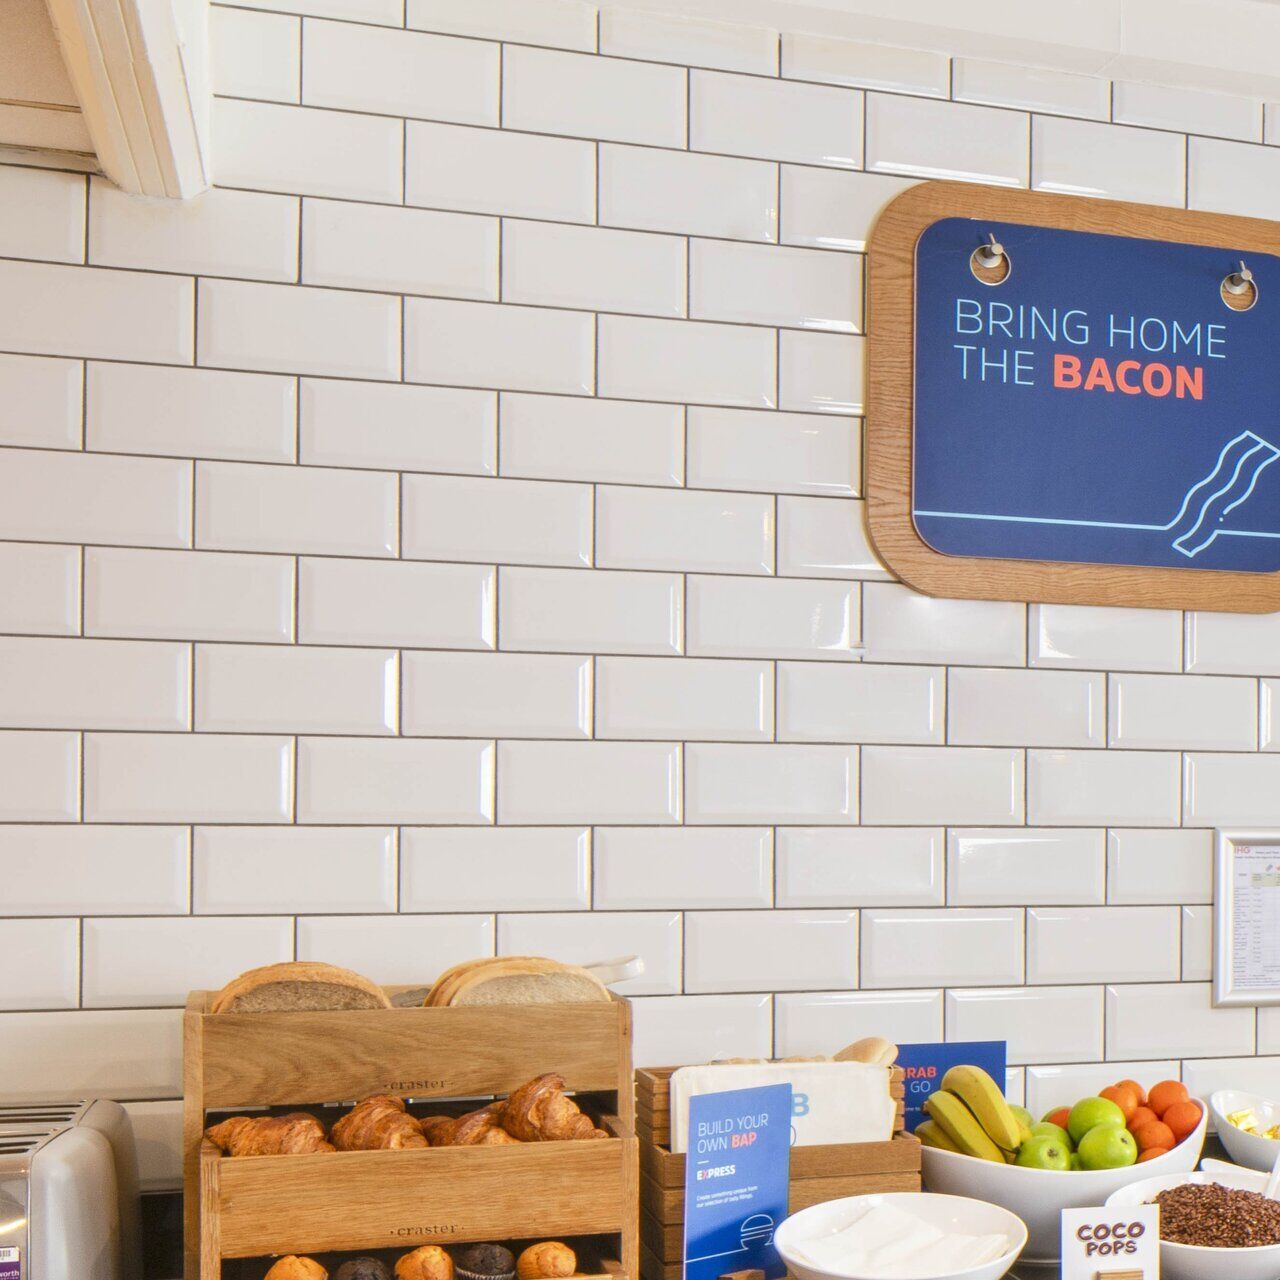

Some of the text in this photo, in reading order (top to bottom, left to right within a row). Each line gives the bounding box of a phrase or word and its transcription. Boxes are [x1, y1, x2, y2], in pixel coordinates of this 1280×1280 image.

[955, 298, 1227, 359] BRING HOME
[954, 344, 1204, 400] THE BACON
[903, 1066, 937, 1078] RAB
[391, 1080, 446, 1090] craster
[910, 1080, 931, 1093] GO
[698, 1113, 769, 1137] BUILD YOUR
[697, 1132, 757, 1153] OWN BAP
[696, 1164, 736, 1181] EXPRESS
[397, 1224, 458, 1235] craster
[1077, 1221, 1146, 1241] COCO
[1086, 1240, 1138, 1257] POPS
